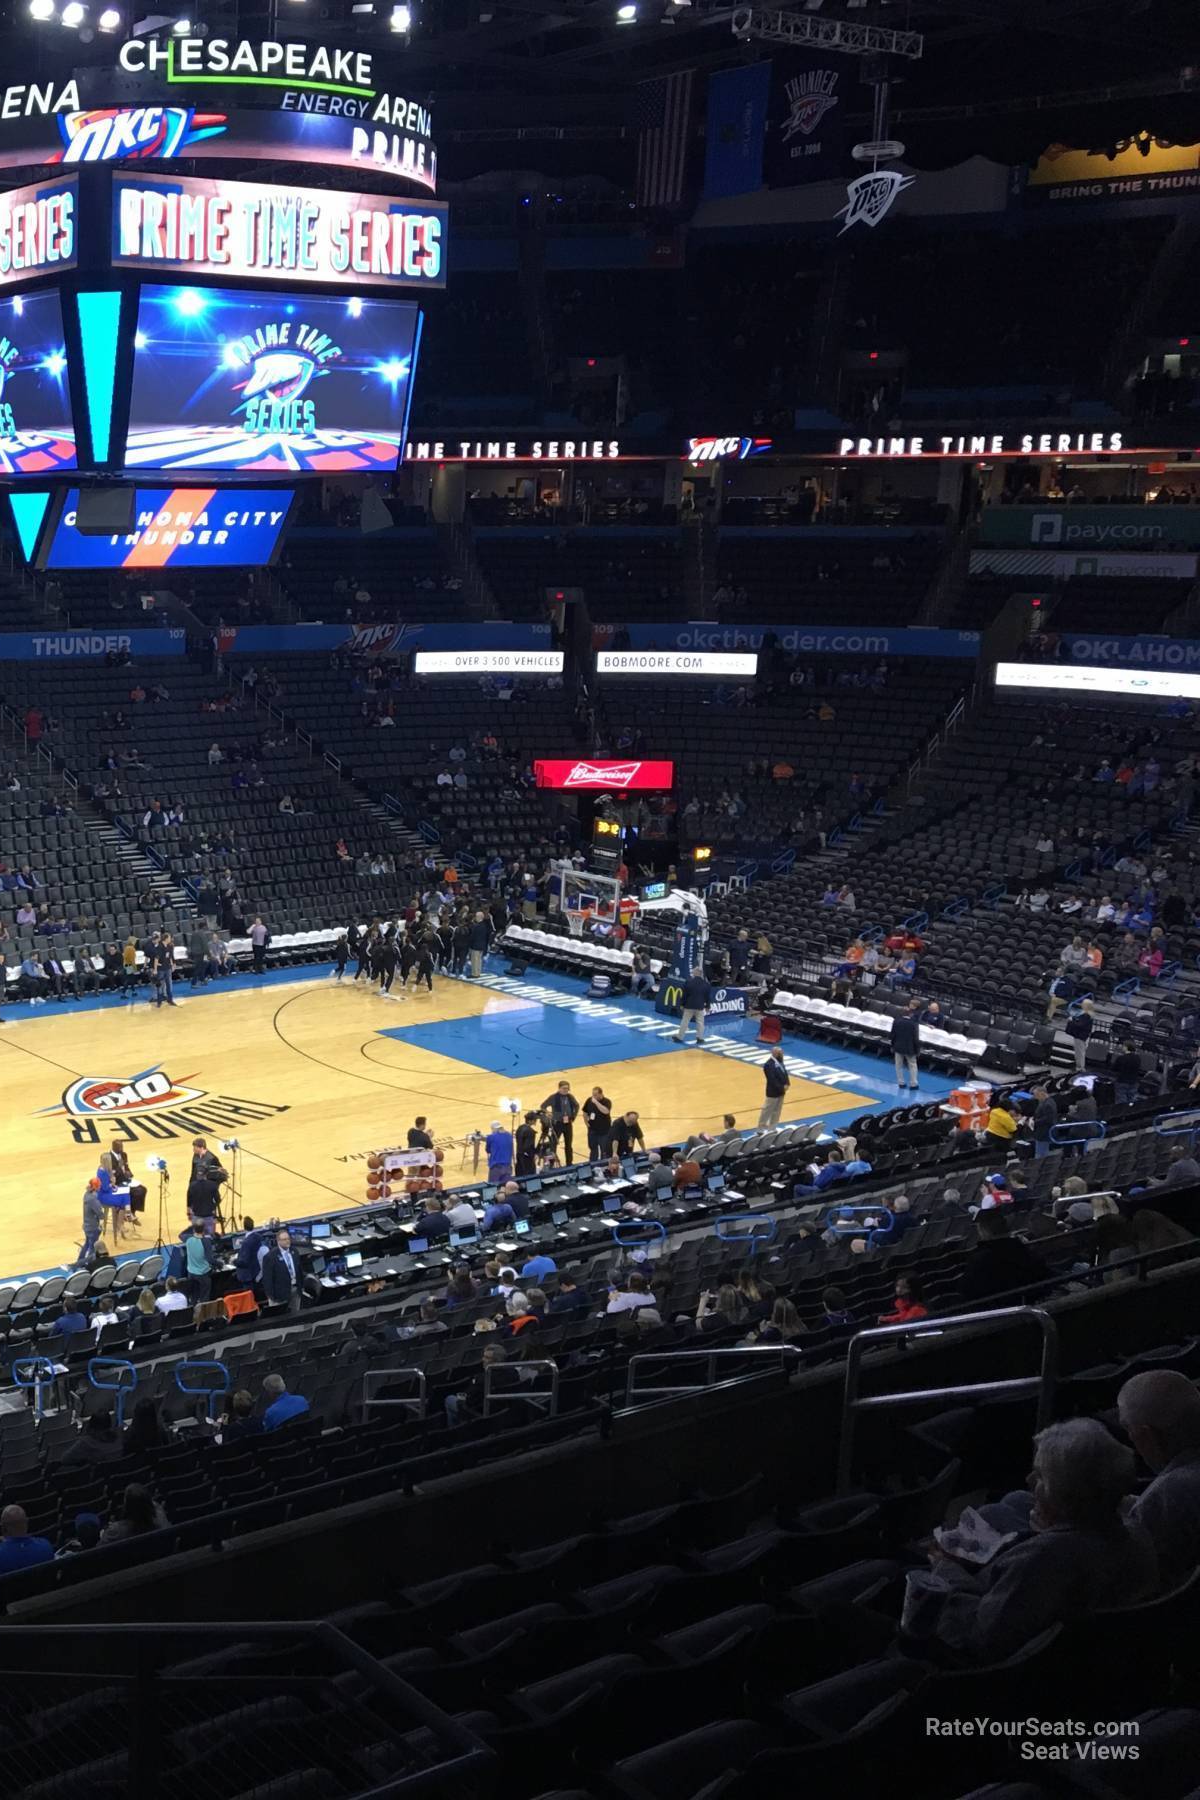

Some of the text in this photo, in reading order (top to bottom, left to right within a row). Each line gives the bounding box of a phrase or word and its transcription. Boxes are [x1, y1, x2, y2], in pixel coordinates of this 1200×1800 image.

[120, 39, 373, 85] CHESAPEAKE
[783, 69, 840, 103] THUNDER
[281, 91, 370, 119] ENERGY
[372, 93, 433, 139] ARENA
[350, 127, 426, 178] PRIME
[1050, 184, 1104, 200] BRING
[1108, 179, 1143, 195] THE
[0, 190, 74, 273] SERIES
[120, 187, 442, 278] PRIME TIME SERIES
[295, 322, 343, 364] TIME
[242, 398, 316, 435] SERIES
[460, 441, 518, 459] TIME
[532, 440, 620, 459] SERIES
[840, 432, 1124, 456] PRIME TIME SERIES
[224, 510, 283, 527] CITY
[1065, 520, 1164, 543] paycom
[31, 634, 133, 657] THUNDER
[168, 628, 185, 640] 107
[220, 627, 237, 638] 108
[454, 656, 480, 667] OVER
[513, 655, 561, 667] VEHICLES
[1071, 638, 1200, 665] OKLAHOM
[571, 767, 634, 781] Budweiser
[471, 972, 622, 1017] OKLAHOMA
[92, 1070, 173, 1111] OKC
[66, 1094, 293, 1145] THUNDER
